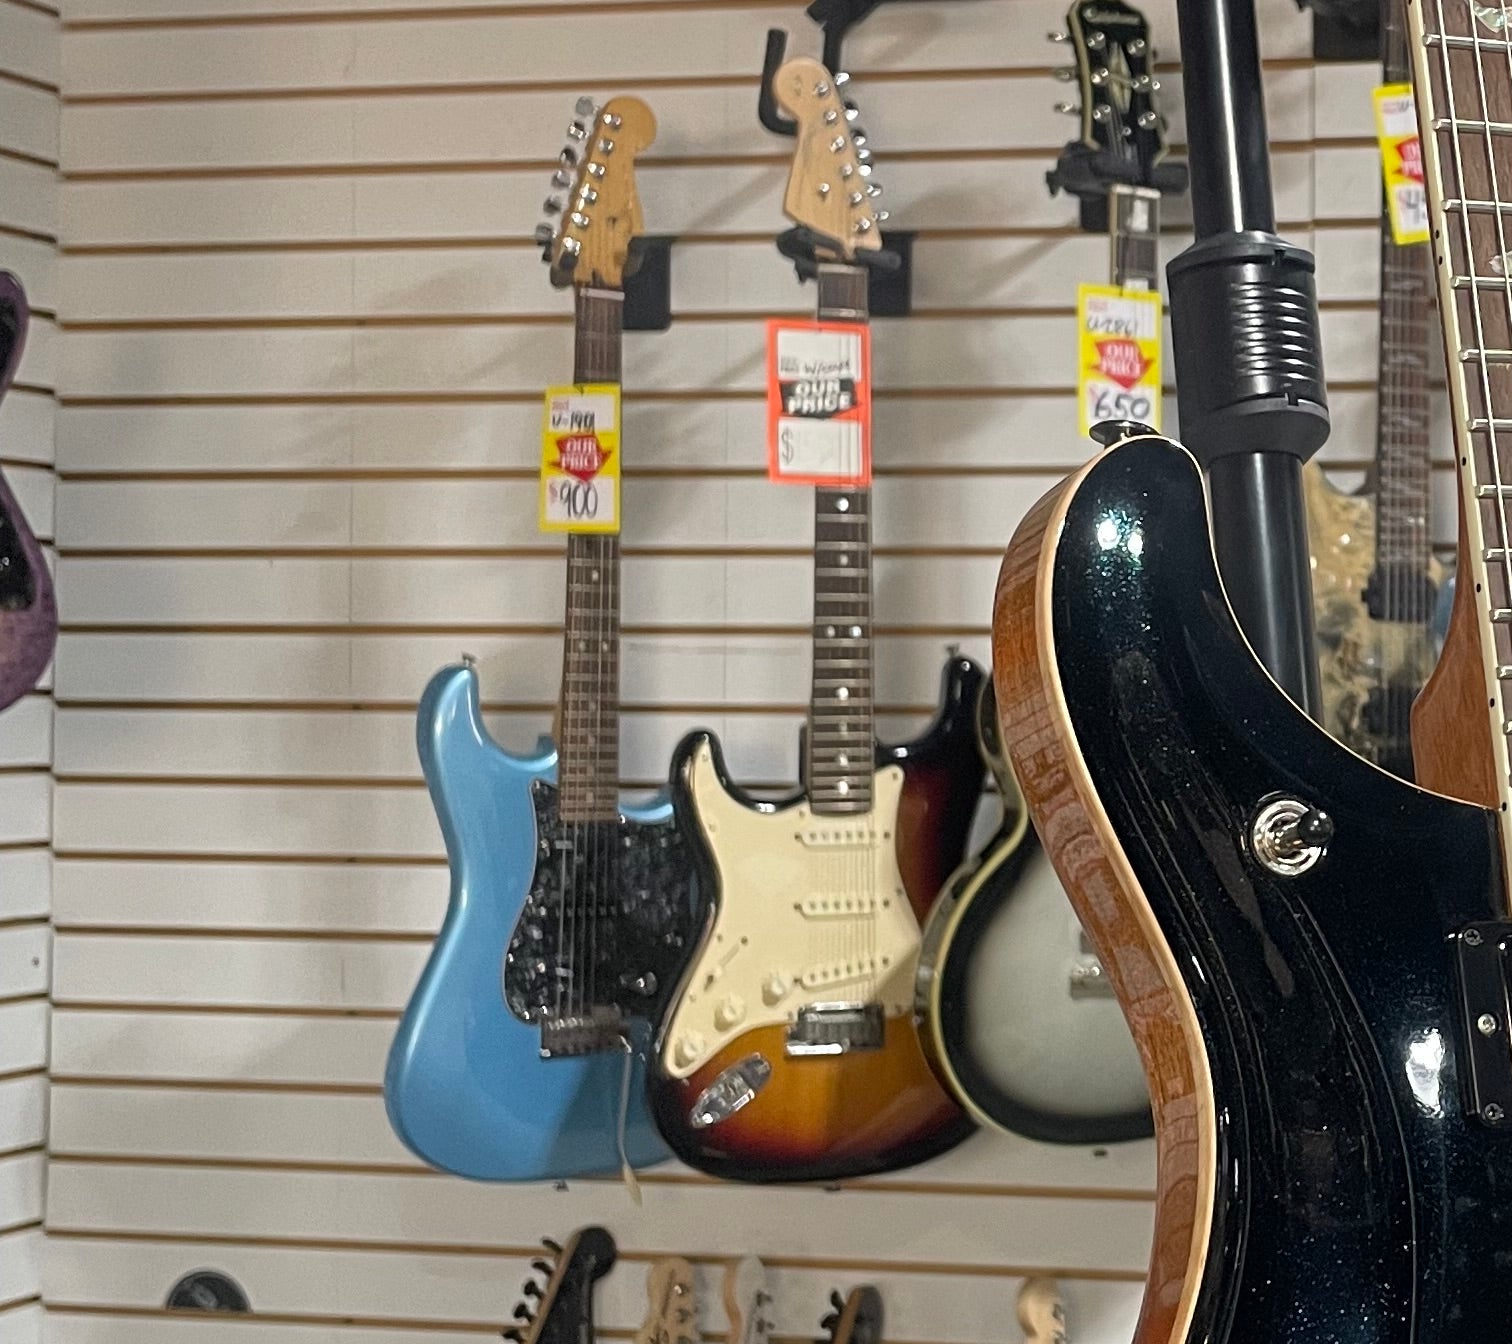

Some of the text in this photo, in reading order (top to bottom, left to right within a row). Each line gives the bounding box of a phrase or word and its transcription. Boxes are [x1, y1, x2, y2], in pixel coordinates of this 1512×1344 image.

[795, 381, 840, 398] OUR
[788, 392, 852, 415] PRICE
[566, 437, 598, 453] OUR
